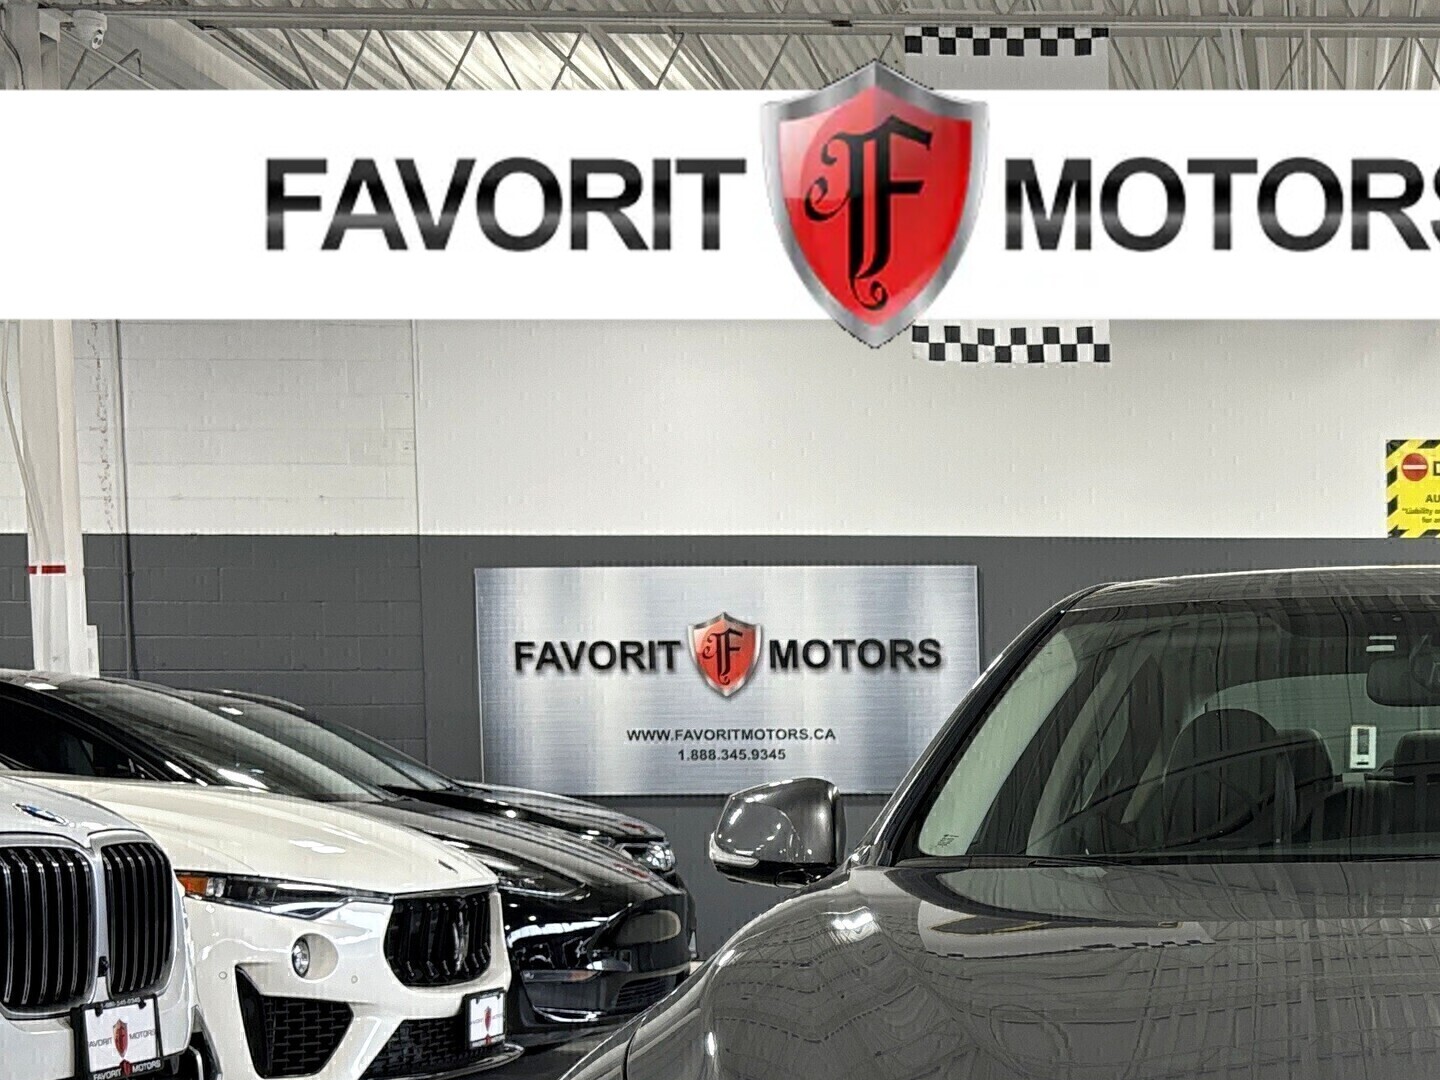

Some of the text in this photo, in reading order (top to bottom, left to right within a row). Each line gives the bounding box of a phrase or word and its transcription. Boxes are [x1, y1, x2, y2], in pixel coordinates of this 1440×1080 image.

[514, 639, 681, 671] FAVORIT
[769, 638, 942, 670] MOTORS
[626, 728, 837, 741] WWW.FAVORITMOTORS.CA
[677, 749, 786, 761] 1.888.345.9345
